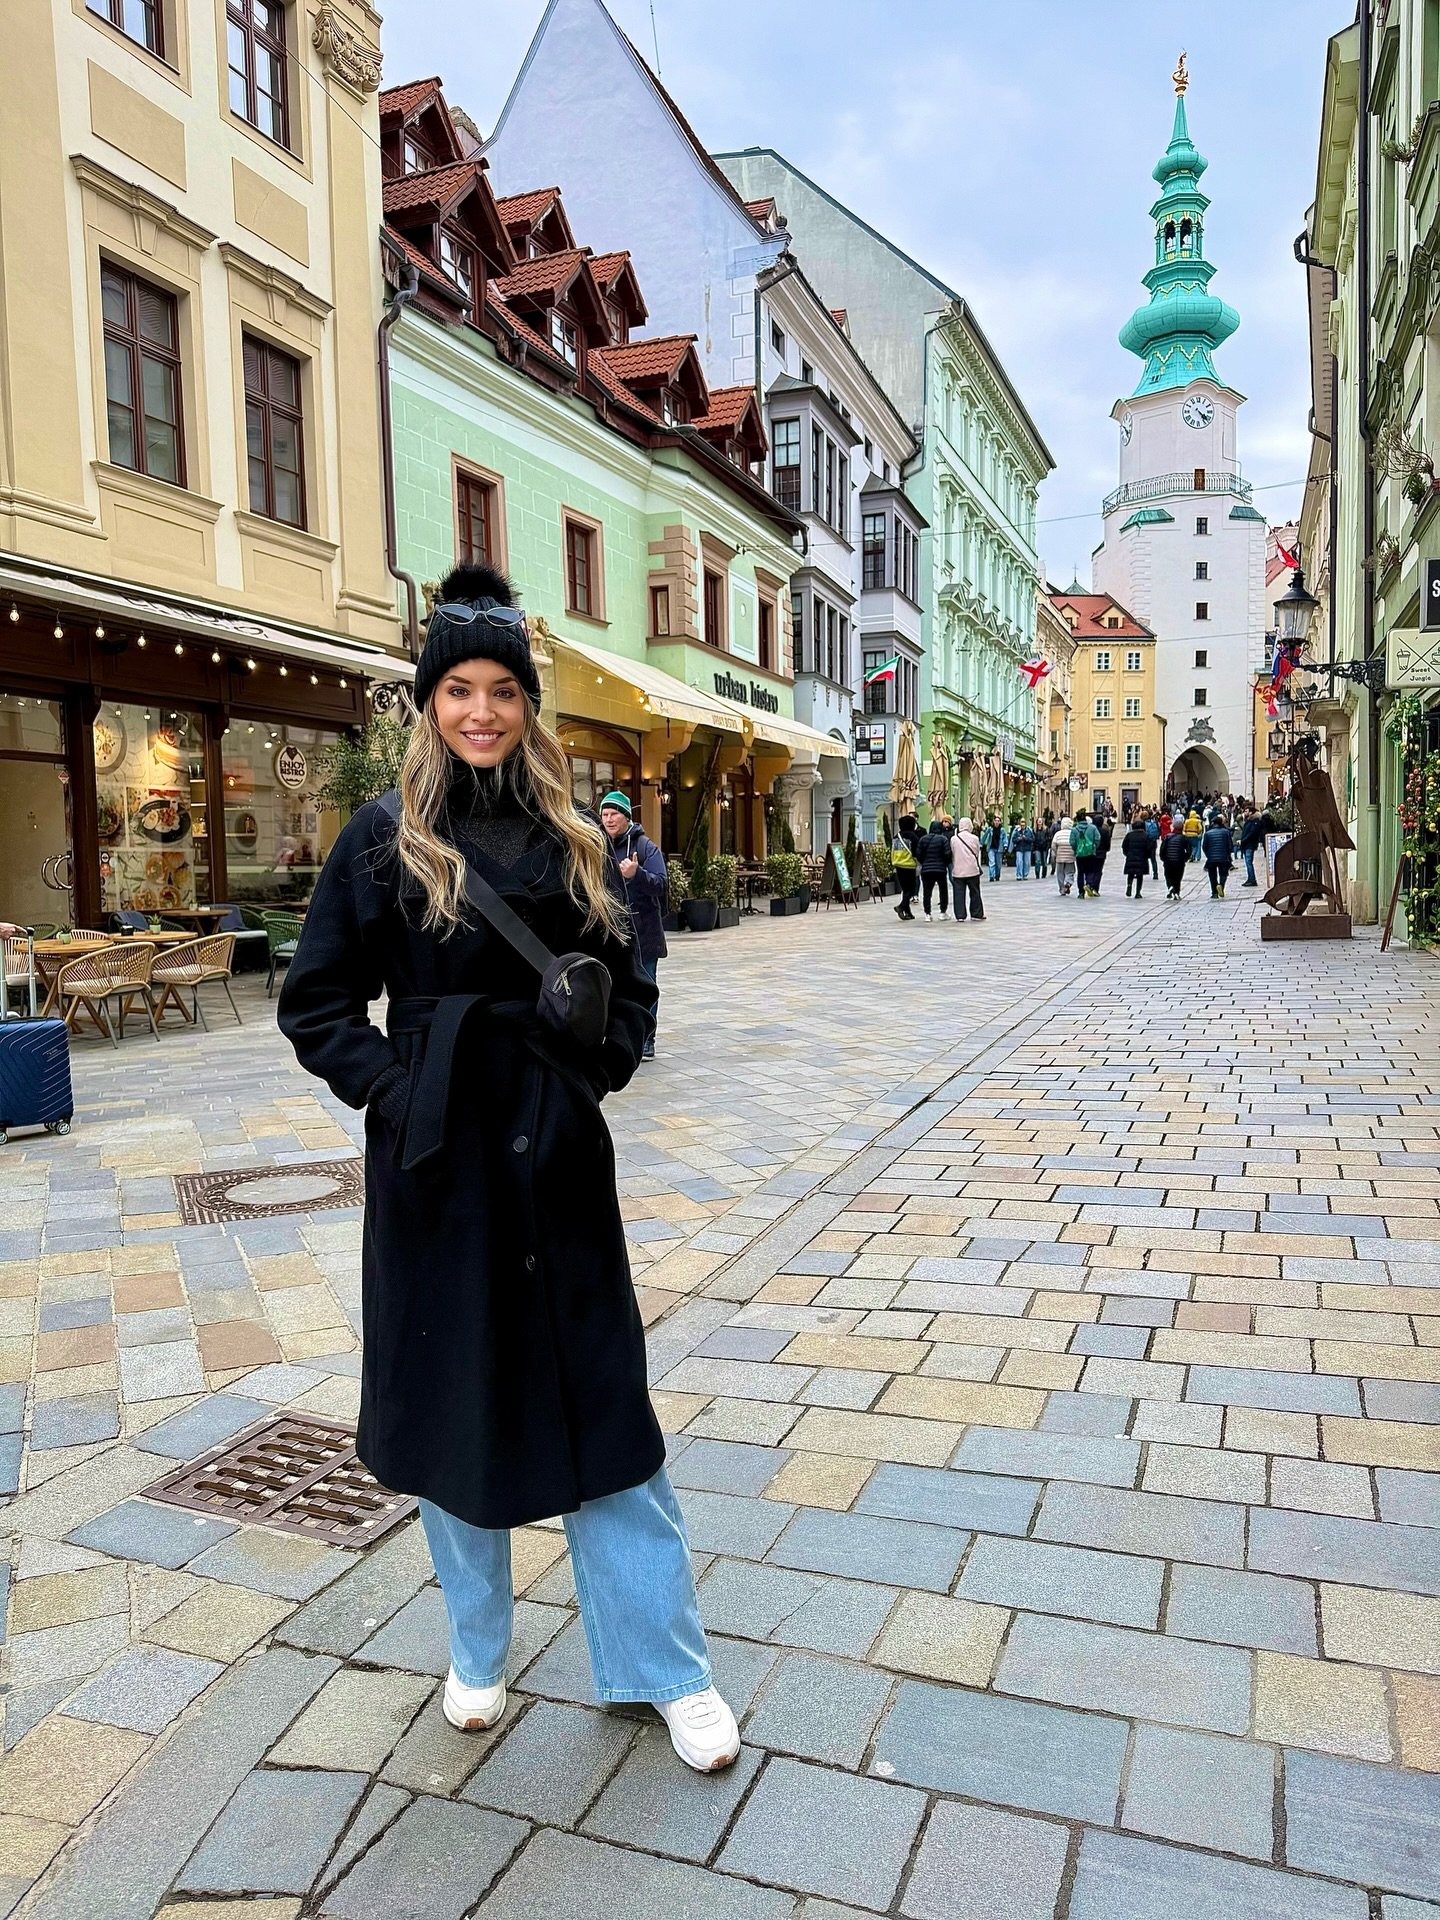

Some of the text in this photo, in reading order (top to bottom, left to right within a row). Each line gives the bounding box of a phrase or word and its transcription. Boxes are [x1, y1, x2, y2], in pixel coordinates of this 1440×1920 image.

[713, 671, 778, 714] urban bistro
[280, 761, 305, 769] ENJOY
